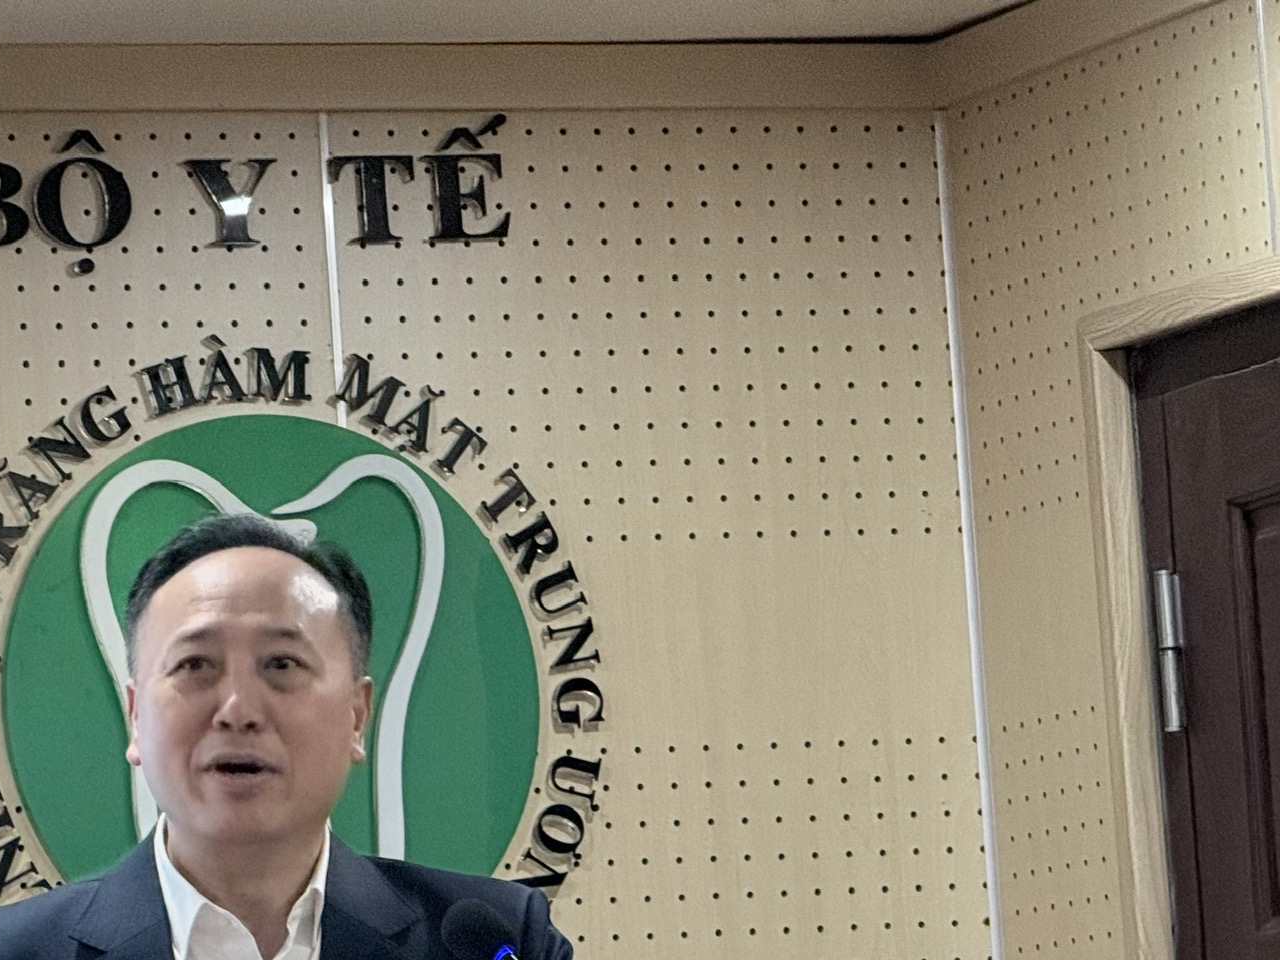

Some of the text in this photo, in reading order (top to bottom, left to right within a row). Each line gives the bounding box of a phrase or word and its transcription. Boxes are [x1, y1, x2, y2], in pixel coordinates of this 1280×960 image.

[179, 157, 278, 250] Y
[326, 113, 512, 247] TẾ
[136, 334, 313, 418] HÀM
[328, 353, 488, 478] MẶT
[477, 468, 606, 730] TRUNG
[511, 754, 602, 890] ƯƠN
